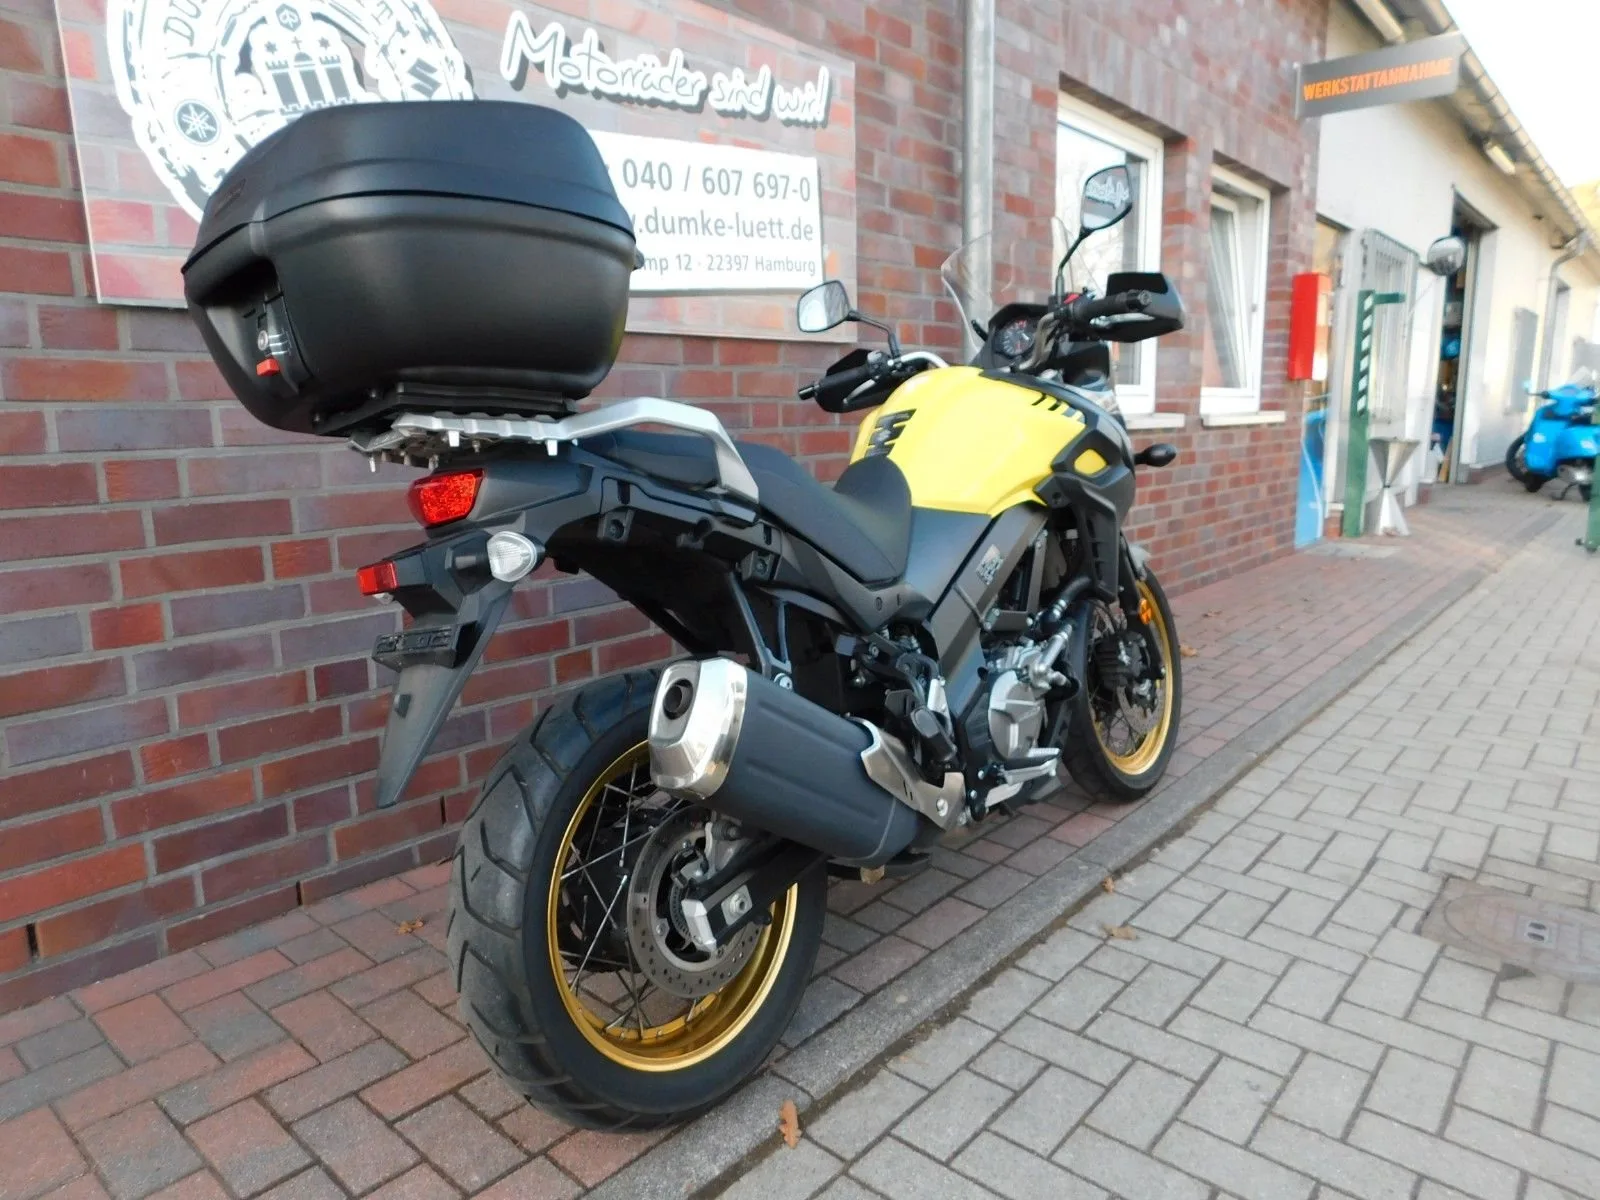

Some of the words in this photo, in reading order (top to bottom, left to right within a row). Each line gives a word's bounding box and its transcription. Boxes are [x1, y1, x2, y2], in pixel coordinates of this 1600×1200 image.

[502, 15, 705, 102] Motorräder
[711, 67, 769, 111] sind
[1303, 57, 1454, 101] WERKSTATTANNAHME
[622, 157, 673, 192] 040
[683, 165, 691, 192] /
[702, 166, 742, 197] 607
[753, 171, 811, 202] 697-0
[676, 254, 693, 271] 12
[707, 254, 749, 272] 22397
[755, 256, 816, 277] Hamburg
